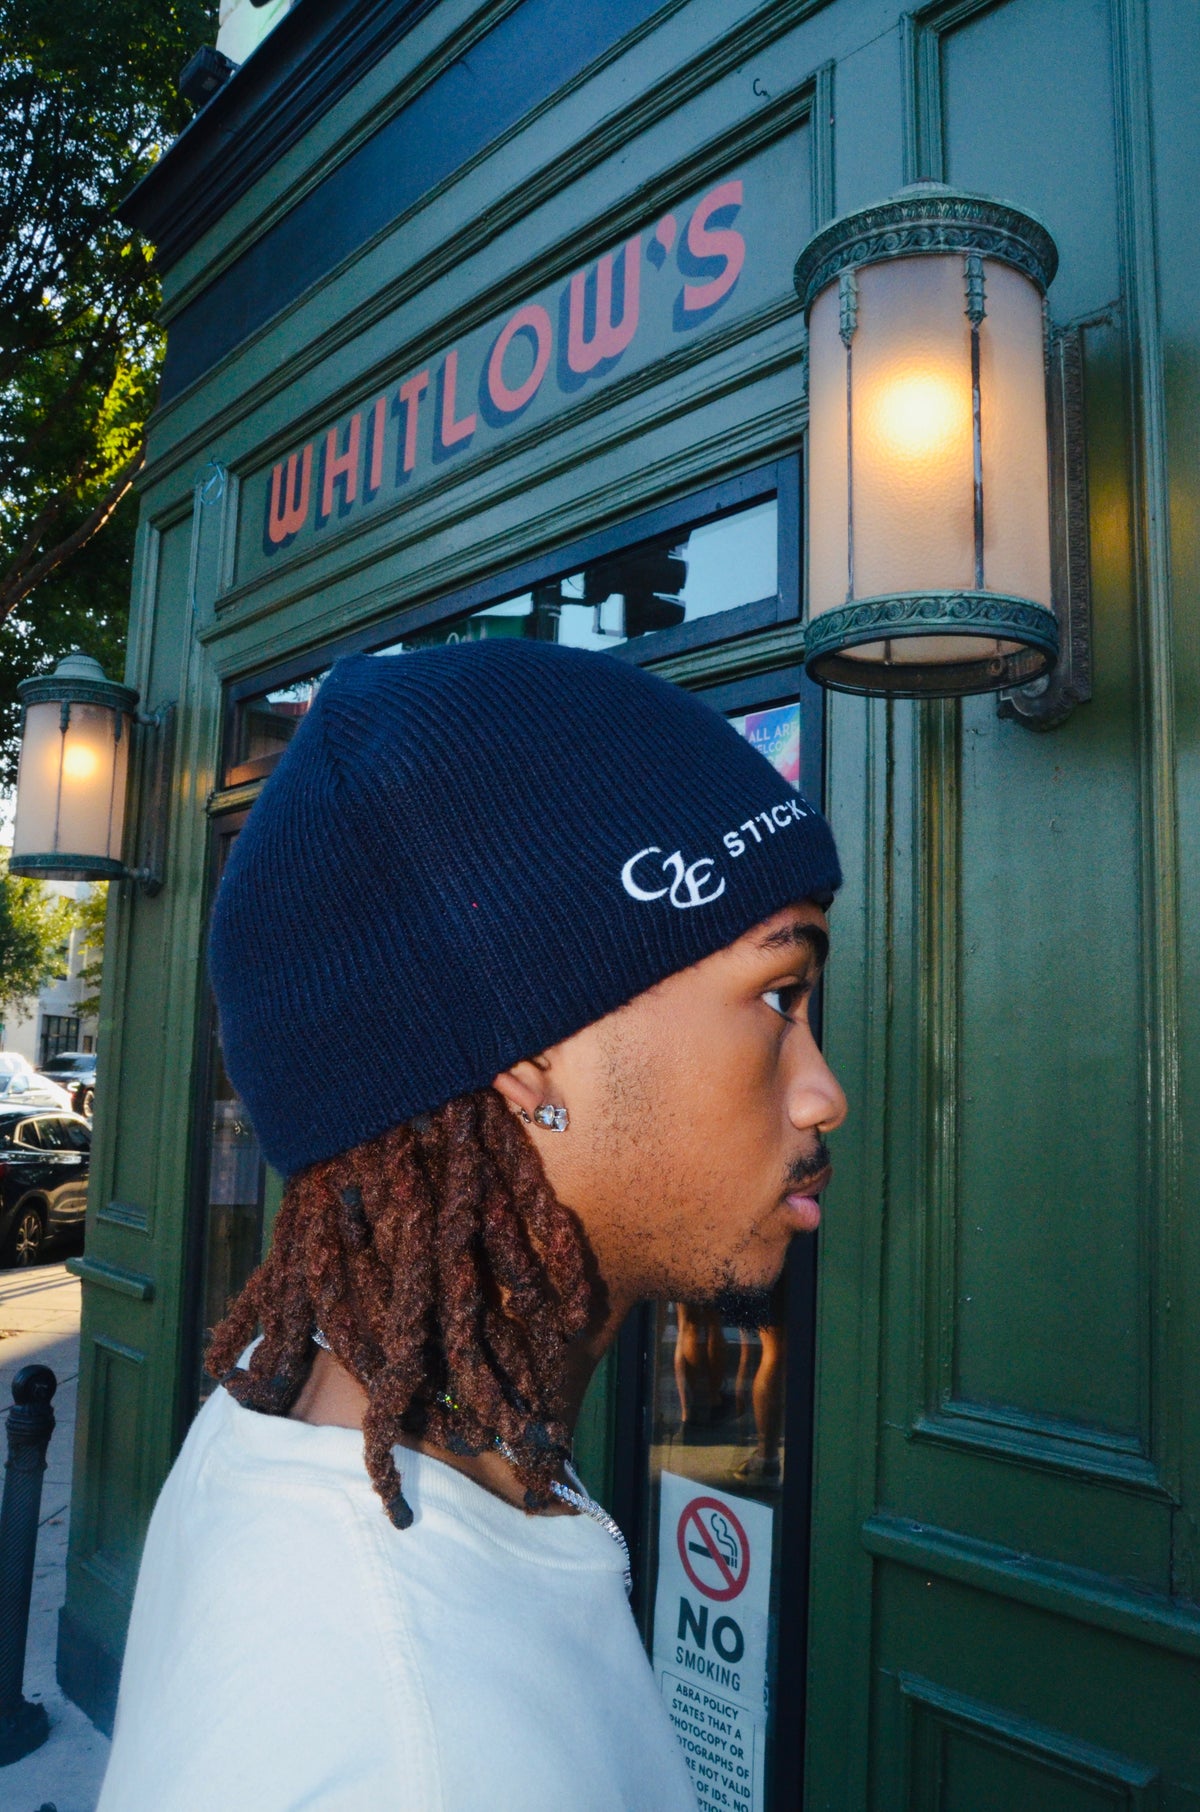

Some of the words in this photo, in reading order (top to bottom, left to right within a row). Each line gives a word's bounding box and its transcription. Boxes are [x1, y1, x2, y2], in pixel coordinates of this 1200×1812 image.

[265, 180, 746, 552] WHITLOW'S
[748, 727, 770, 743] ALL
[723, 798, 816, 857] STICK
[677, 1596, 744, 1663] NO
[675, 1646, 741, 1691] SMOKING
[672, 1698, 705, 1722] STATES
[707, 1715, 732, 1735] THAT
[734, 1728, 742, 1740] A
[676, 1684, 701, 1704] ABRA
[703, 1695, 739, 1720] POLICY
[676, 1734, 734, 1772] TOGRAPHS
[736, 1765, 750, 1780] OF
[729, 1744, 744, 1760] OR
[685, 1756, 697, 1771] RE
[698, 1763, 719, 1782] NOT
[721, 1774, 751, 1799] VALID
[696, 1780, 709, 1794] OF
[711, 1787, 730, 1807] IDS.
[733, 1799, 749, 1812] NO
